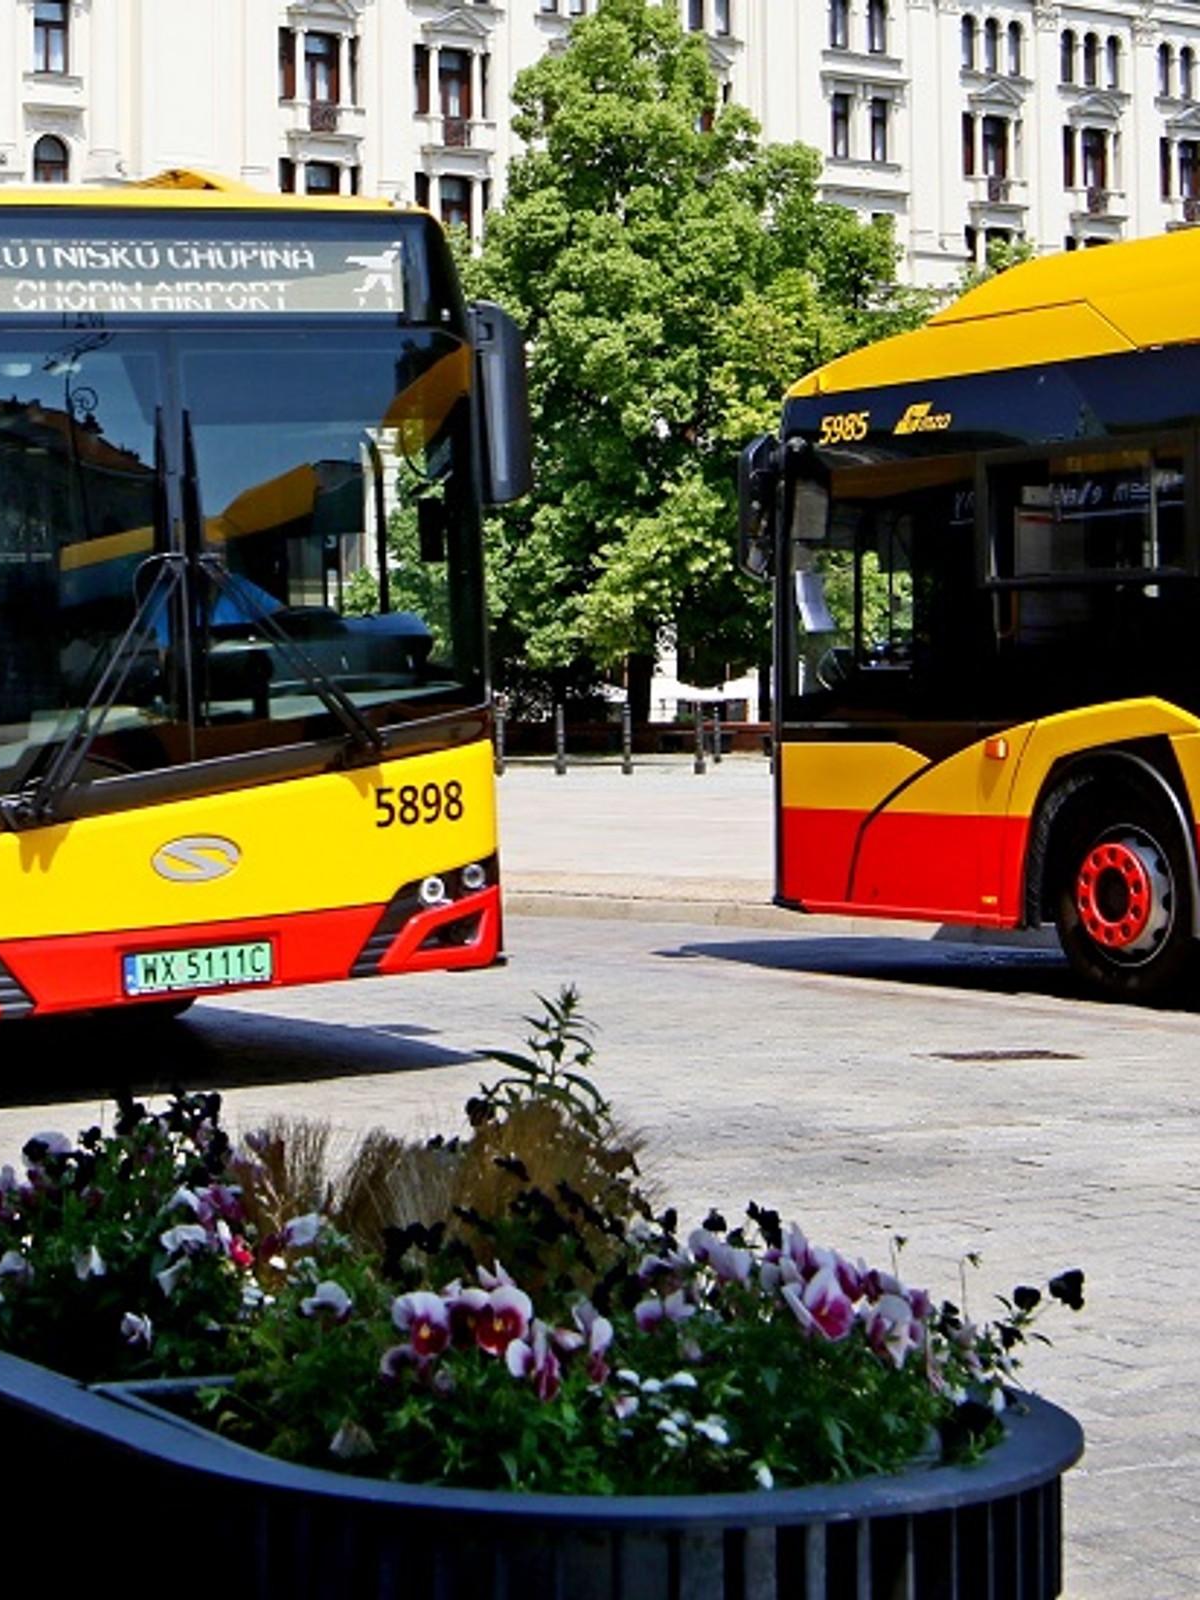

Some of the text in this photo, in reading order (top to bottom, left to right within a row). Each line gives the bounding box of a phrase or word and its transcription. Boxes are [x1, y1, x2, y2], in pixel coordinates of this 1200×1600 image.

[819, 411, 870, 444] 5985
[375, 780, 464, 828] 5898
[142, 945, 265, 984] WX 5111C
